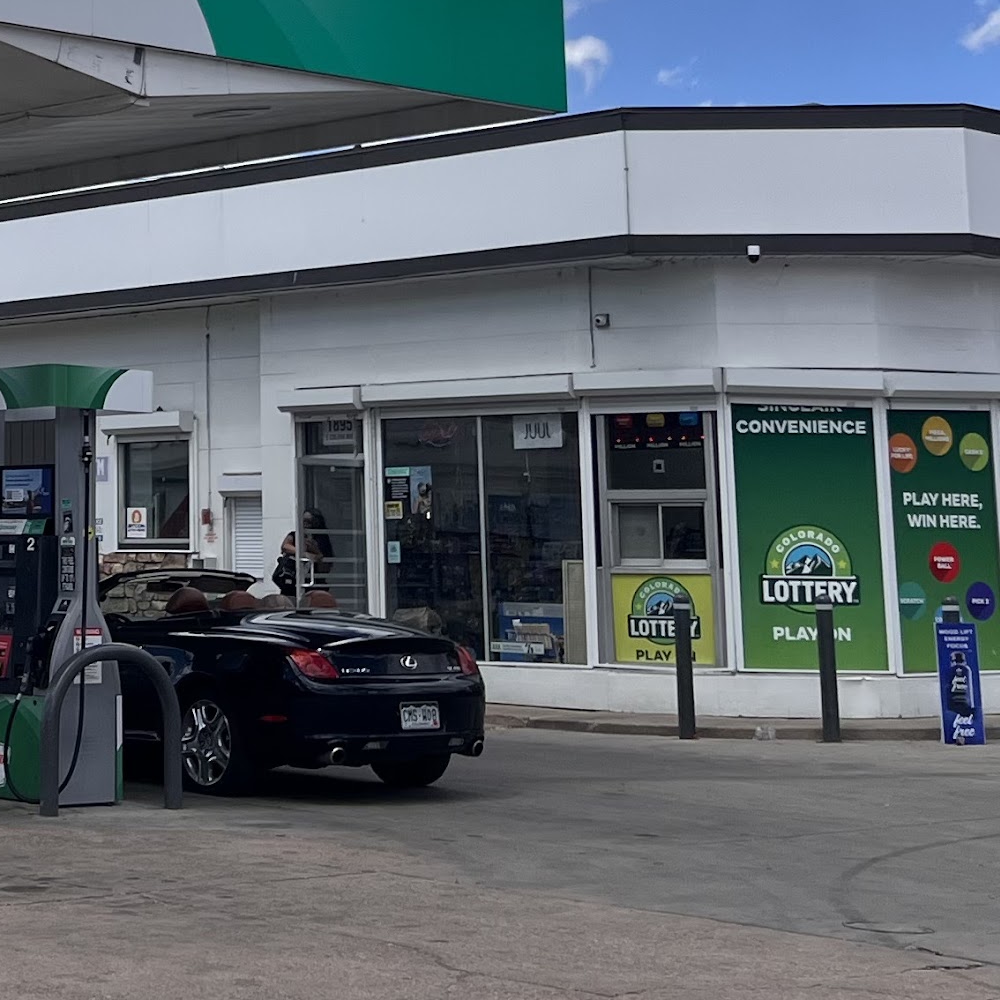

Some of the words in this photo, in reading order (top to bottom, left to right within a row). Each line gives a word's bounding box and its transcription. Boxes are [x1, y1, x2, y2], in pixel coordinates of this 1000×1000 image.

[524, 421, 551, 440] JUUL
[735, 419, 867, 434] CONVENIENCE
[903, 492, 939, 506] PLAY
[942, 493, 983, 510] HERE,
[907, 514, 937, 528] WIN
[940, 515, 981, 529] HERE.
[26, 537, 35, 551] 2
[776, 530, 840, 554] COLORADO
[639, 581, 681, 599] COLORAD
[763, 580, 857, 604] LOTTERY
[630, 619, 698, 638] LOTTEY
[773, 626, 817, 641] PLAY
[834, 627, 851, 642] N
[636, 649, 672, 661] PLAY
[953, 714, 973, 729] feel
[953, 726, 976, 740] free
